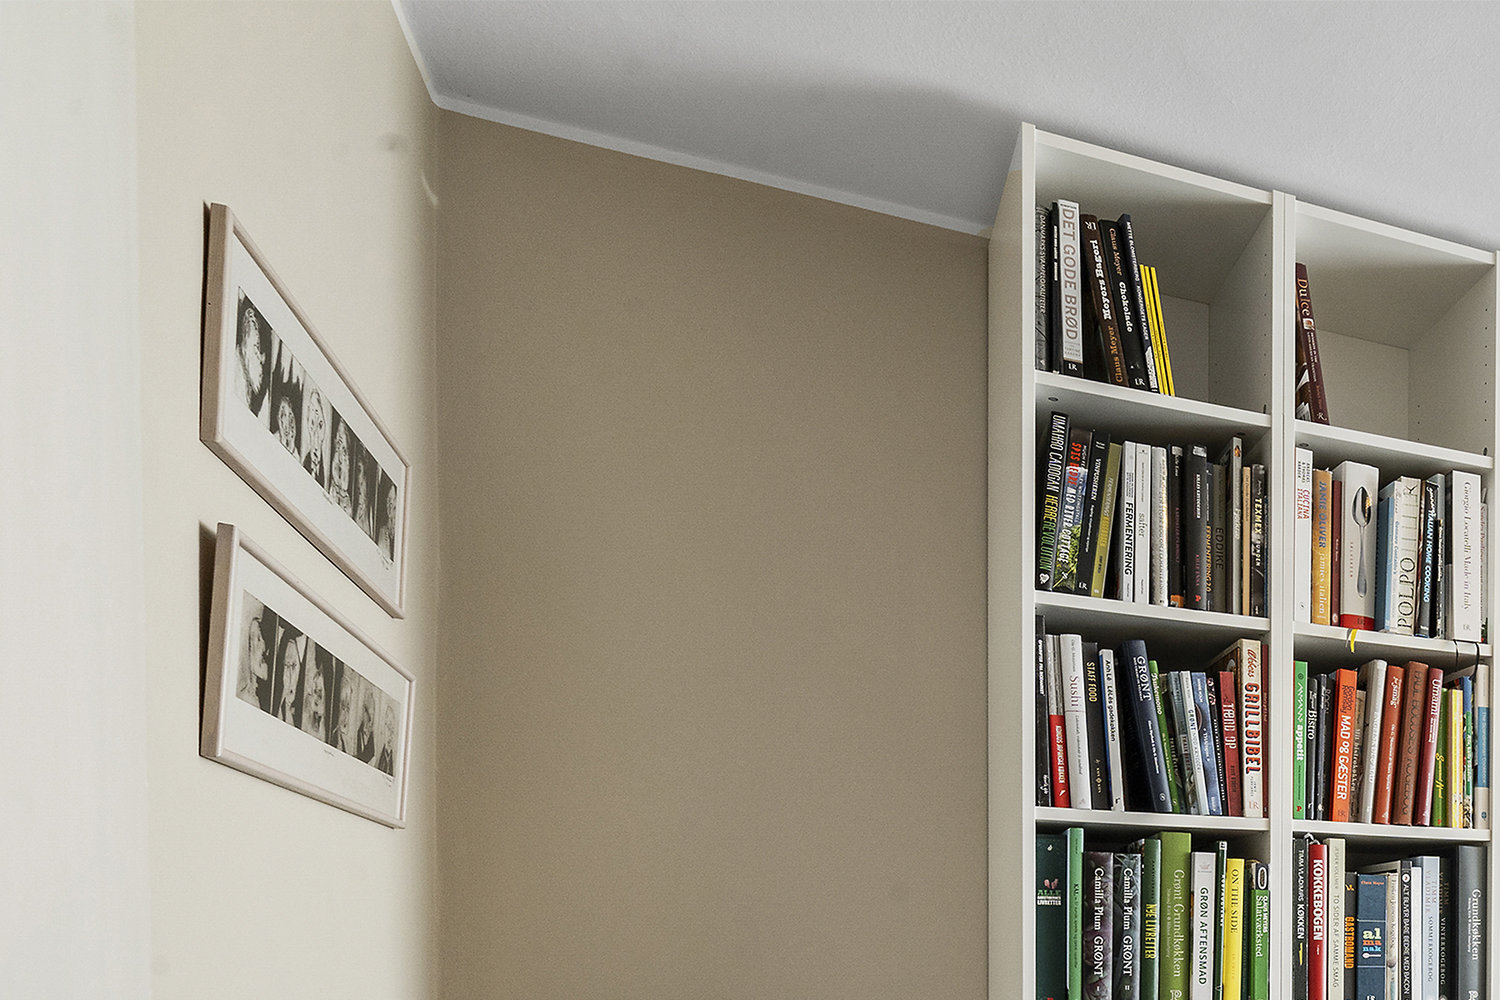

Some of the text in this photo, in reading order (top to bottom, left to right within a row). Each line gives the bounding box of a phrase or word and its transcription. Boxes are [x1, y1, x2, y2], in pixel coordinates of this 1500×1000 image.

[1063, 209, 1075, 241] DET
[1064, 245, 1076, 289] GODE
[1109, 228, 1122, 275] Claus Meyer
[1065, 295, 1077, 339] BRØD
[1298, 279, 1311, 316] Dulce
[1108, 326, 1123, 382] Claus Meyer
[1047, 415, 1066, 492] UMAHRO CADOGAN
[1058, 443, 1081, 563] SPIS BEDRE MED RIVER COTTAGE
[1139, 513, 1147, 537] safter
[1254, 498, 1262, 534] TEXMEX
[1302, 489, 1310, 519] CUCINA
[1318, 481, 1327, 548] JAMIE OLIVER
[1124, 502, 1133, 575] FERMENTERING
[1215, 527, 1224, 569] EDDIKE
[1461, 482, 1471, 610] Giorgio Locatelli Made Italy
[1397, 558, 1415, 629] POLPO
[1423, 566, 1431, 603] COOKING
[1070, 675, 1081, 707] Sushi
[1087, 662, 1097, 702] STAFF FOOD
[1136, 656, 1152, 701] GRØNT
[1431, 678, 1441, 715] Umami
[1245, 682, 1261, 774] GRILLBIBEL
[1293, 725, 1304, 761] appetit
[1307, 710, 1317, 739] Bistro
[1337, 715, 1351, 800] MAD GÆSTER
[1231, 869, 1239, 884] ON
[1094, 868, 1104, 976] Camilla Plum GRØNT
[1123, 868, 1133, 976] Camilla Plum GRØNT
[1146, 904, 1156, 916] NYE
[1313, 860, 1323, 940] KOKKEBOGEN
[1173, 870, 1184, 977] Grønt Grundkøkken
[1199, 888, 1208, 984] GRØN AFTENSMAD
[1345, 917, 1354, 968] GASTROMAND
[1471, 889, 1481, 960] Grundkøkken
